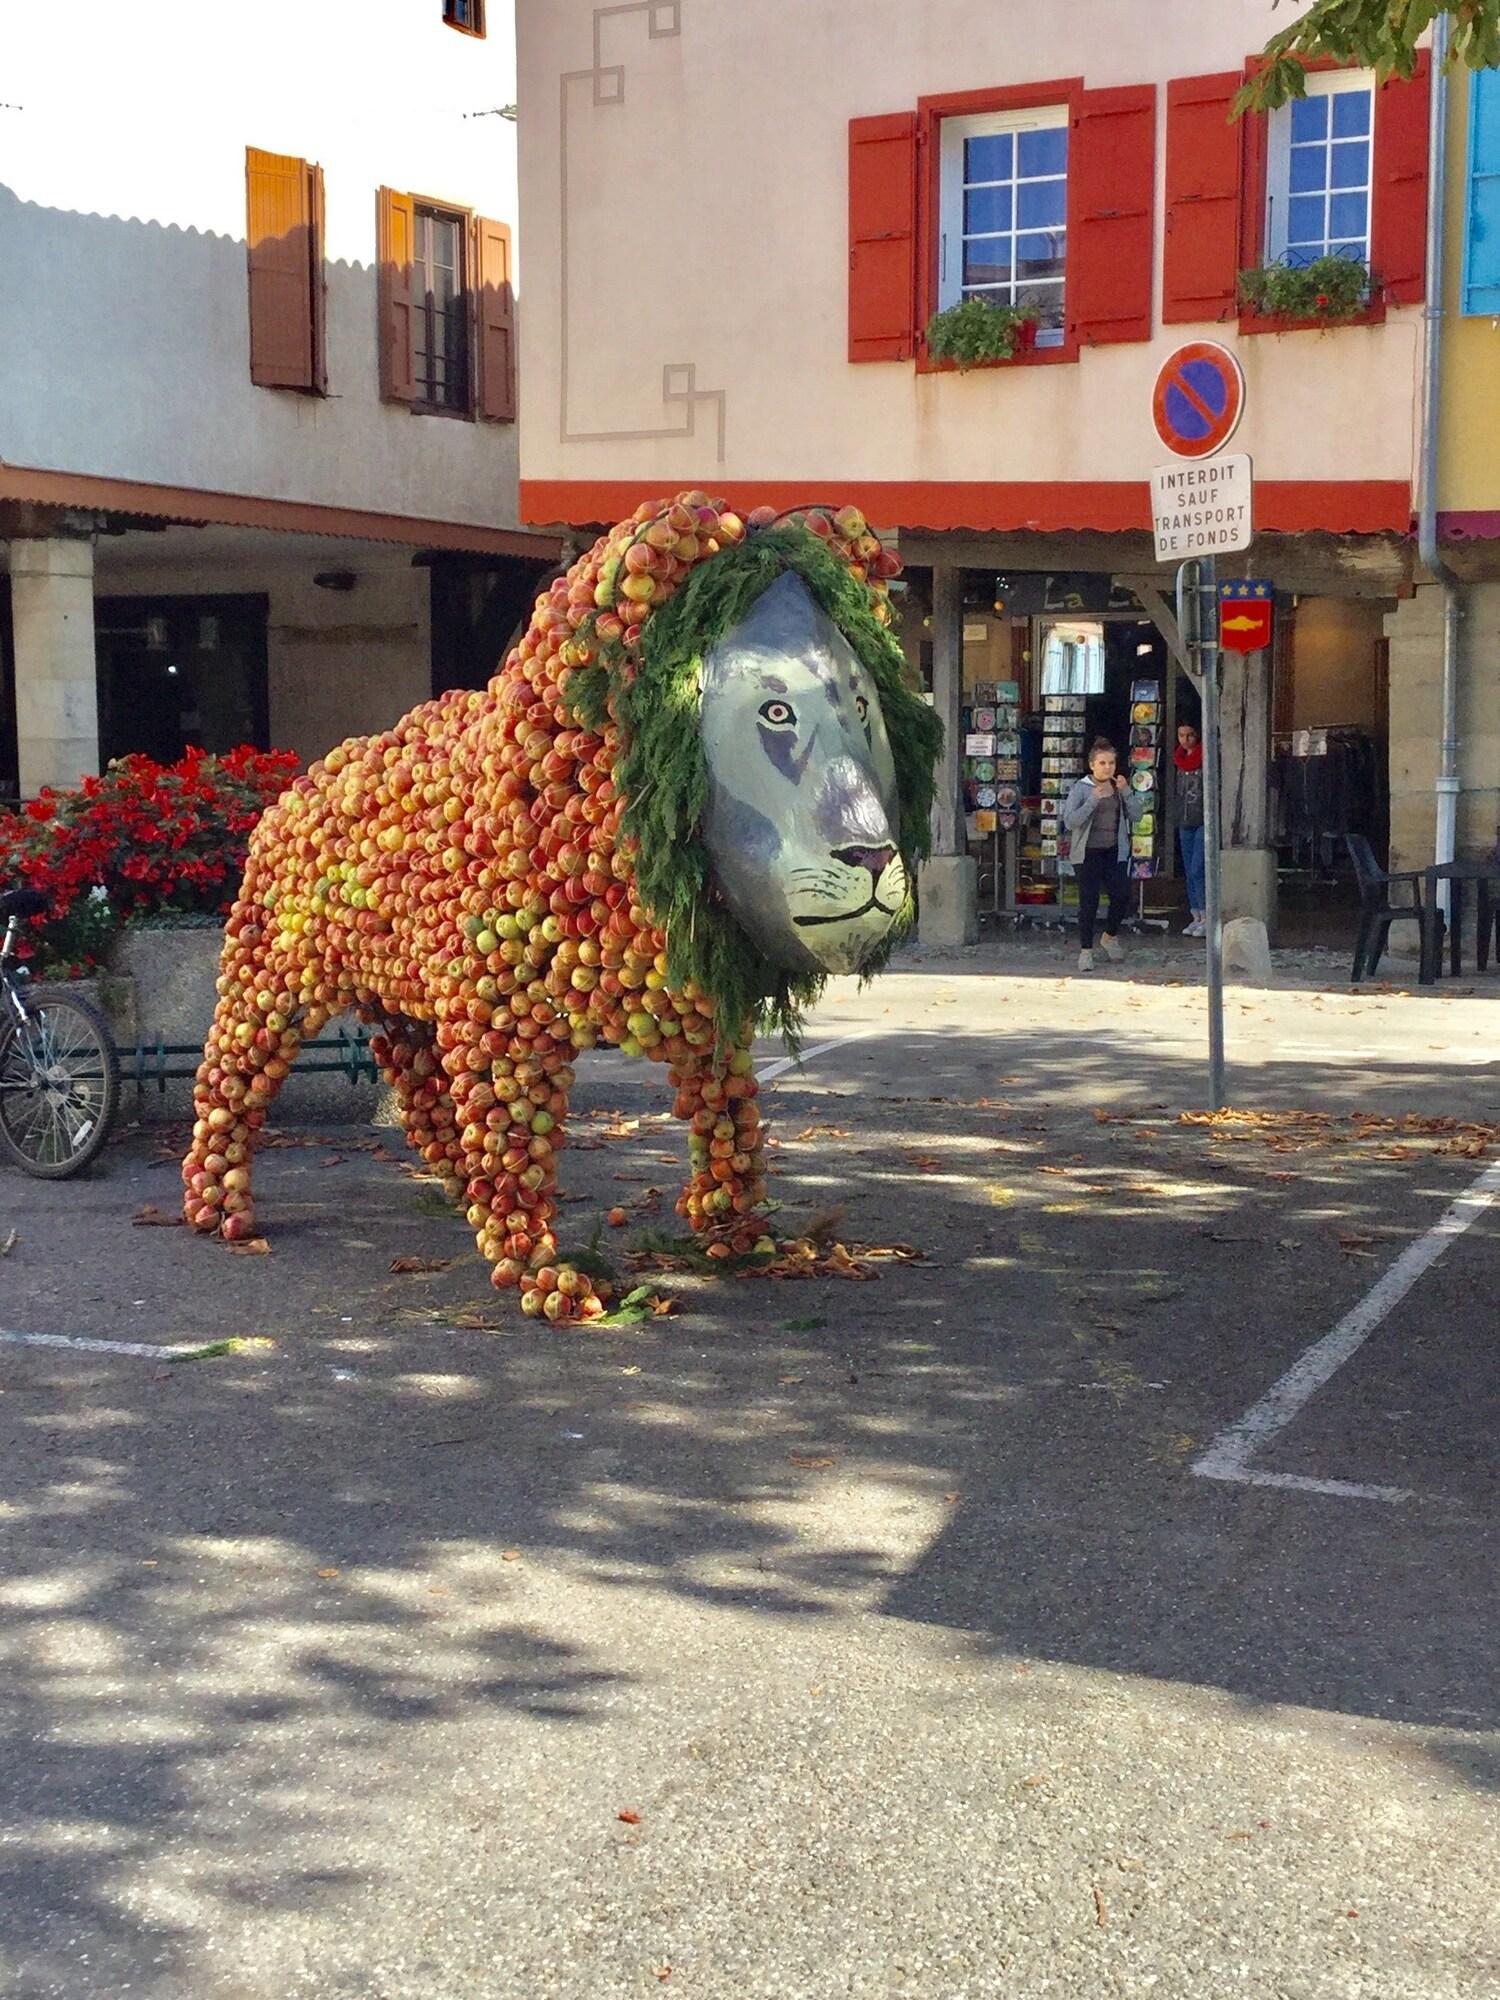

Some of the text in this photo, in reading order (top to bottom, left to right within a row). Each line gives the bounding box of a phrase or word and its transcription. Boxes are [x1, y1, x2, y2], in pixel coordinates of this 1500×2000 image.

[1161, 465, 1234, 489] INTERDIT
[1178, 489, 1218, 507] SAUF
[1155, 506, 1244, 532] TRANSPORT
[1160, 528, 1239, 551] DE FONDS
[1044, 577, 1084, 609] La
